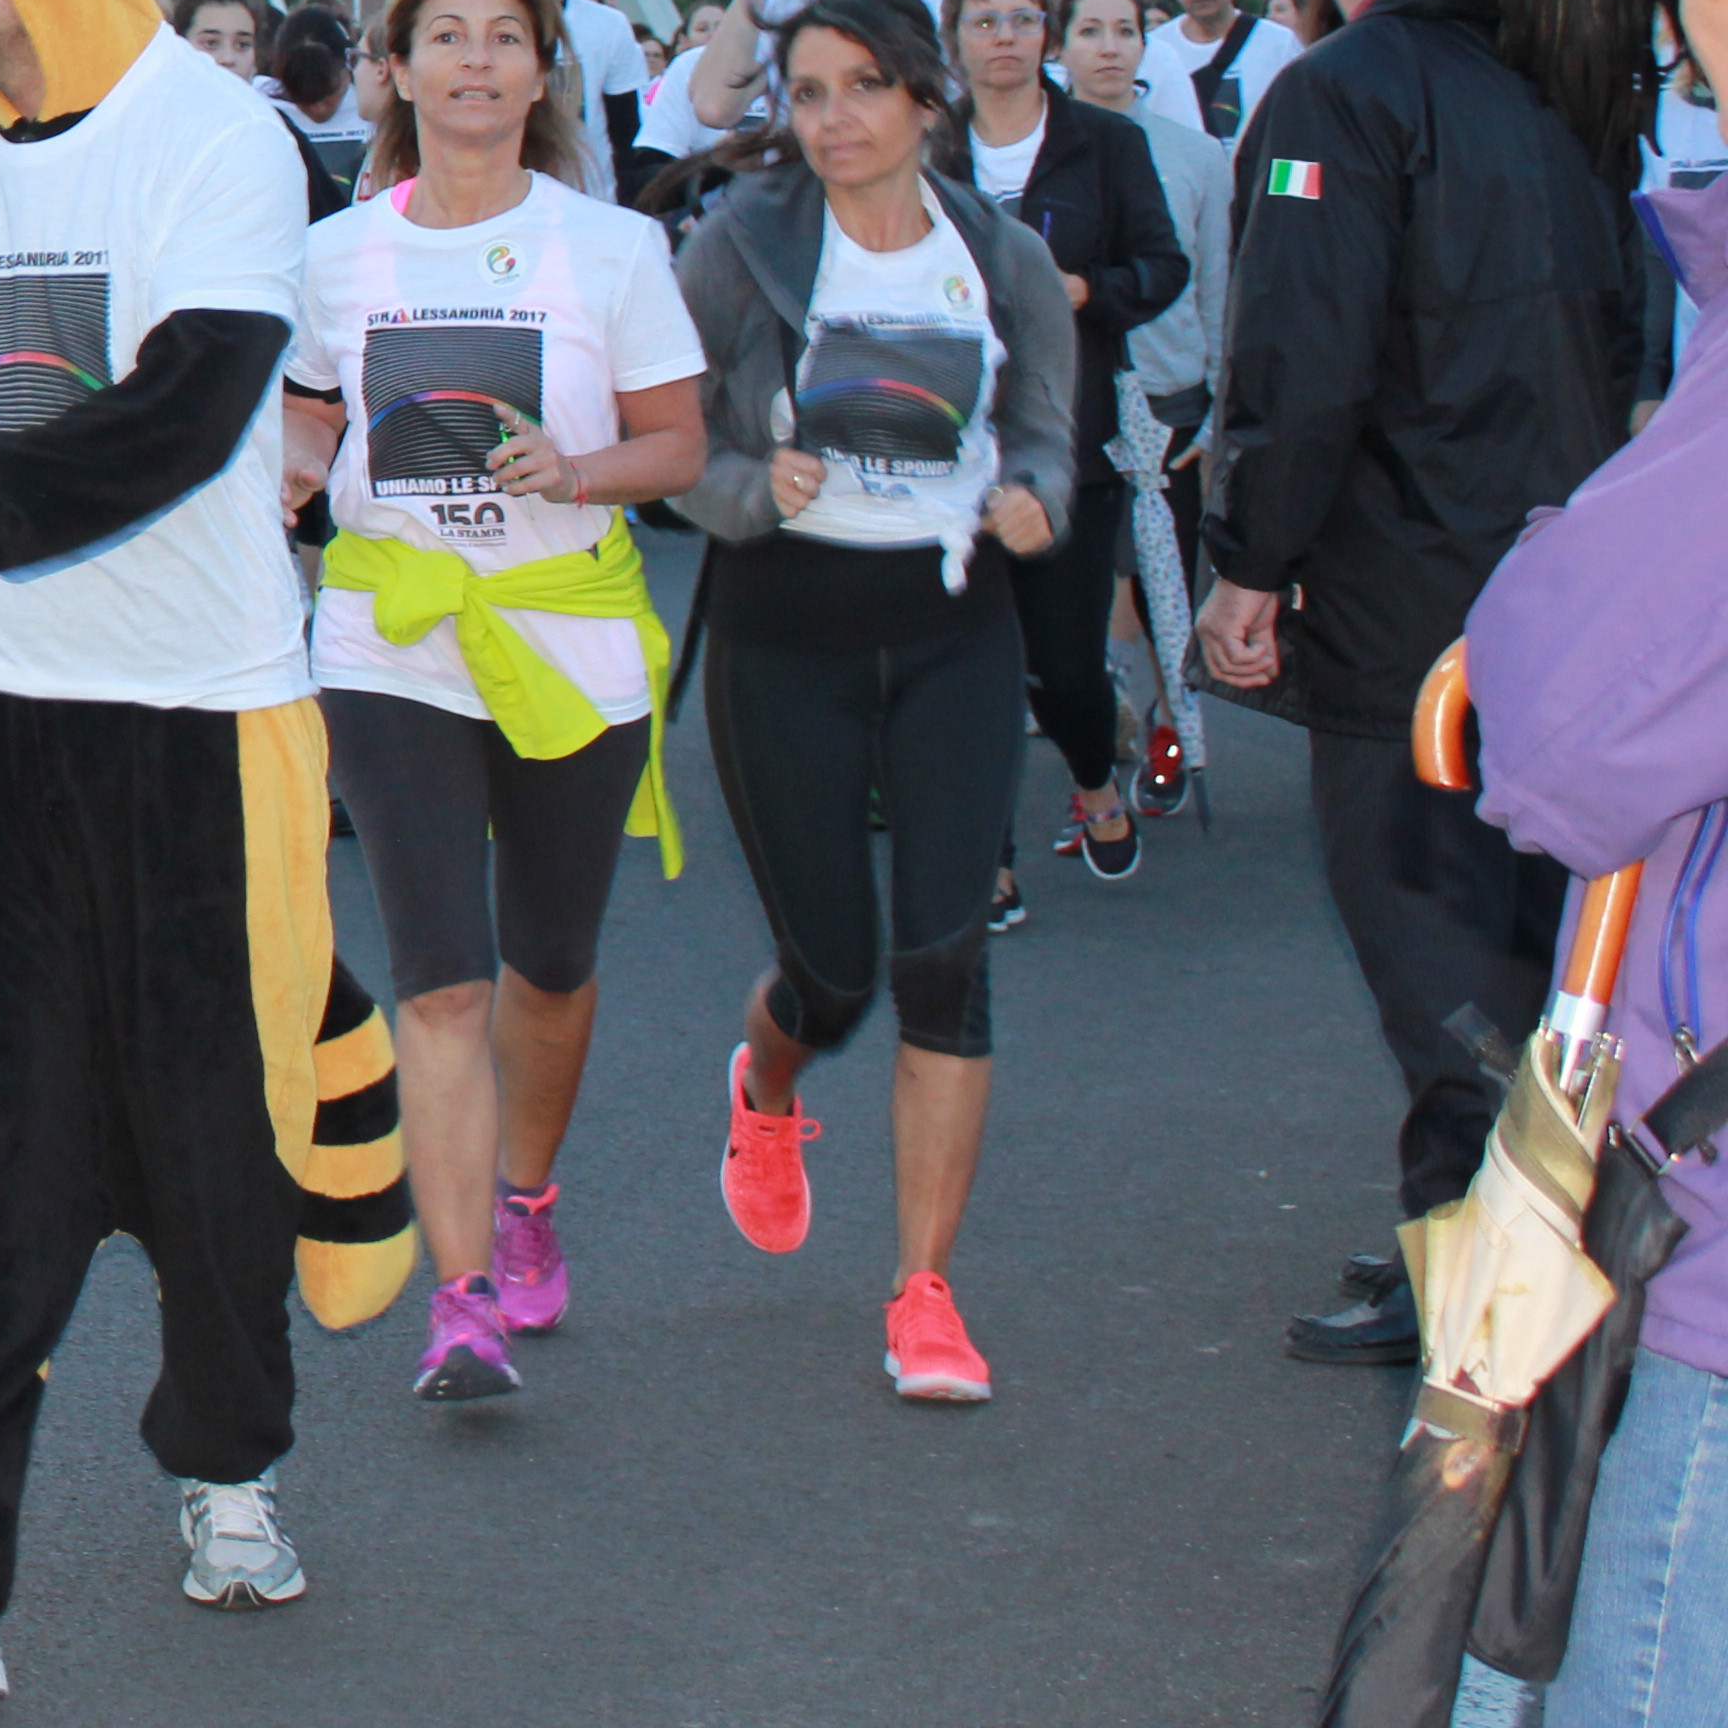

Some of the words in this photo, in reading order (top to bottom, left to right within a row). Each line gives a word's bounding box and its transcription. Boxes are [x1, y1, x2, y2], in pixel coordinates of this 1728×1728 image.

[509, 308, 547, 323] 2017
[864, 456, 886, 473] LE
[375, 477, 446, 496] UNIAMO
[451, 476, 473, 493] LE
[429, 501, 505, 526] 150
[440, 528, 455, 537] LA
[457, 527, 506, 538] STAMPA
